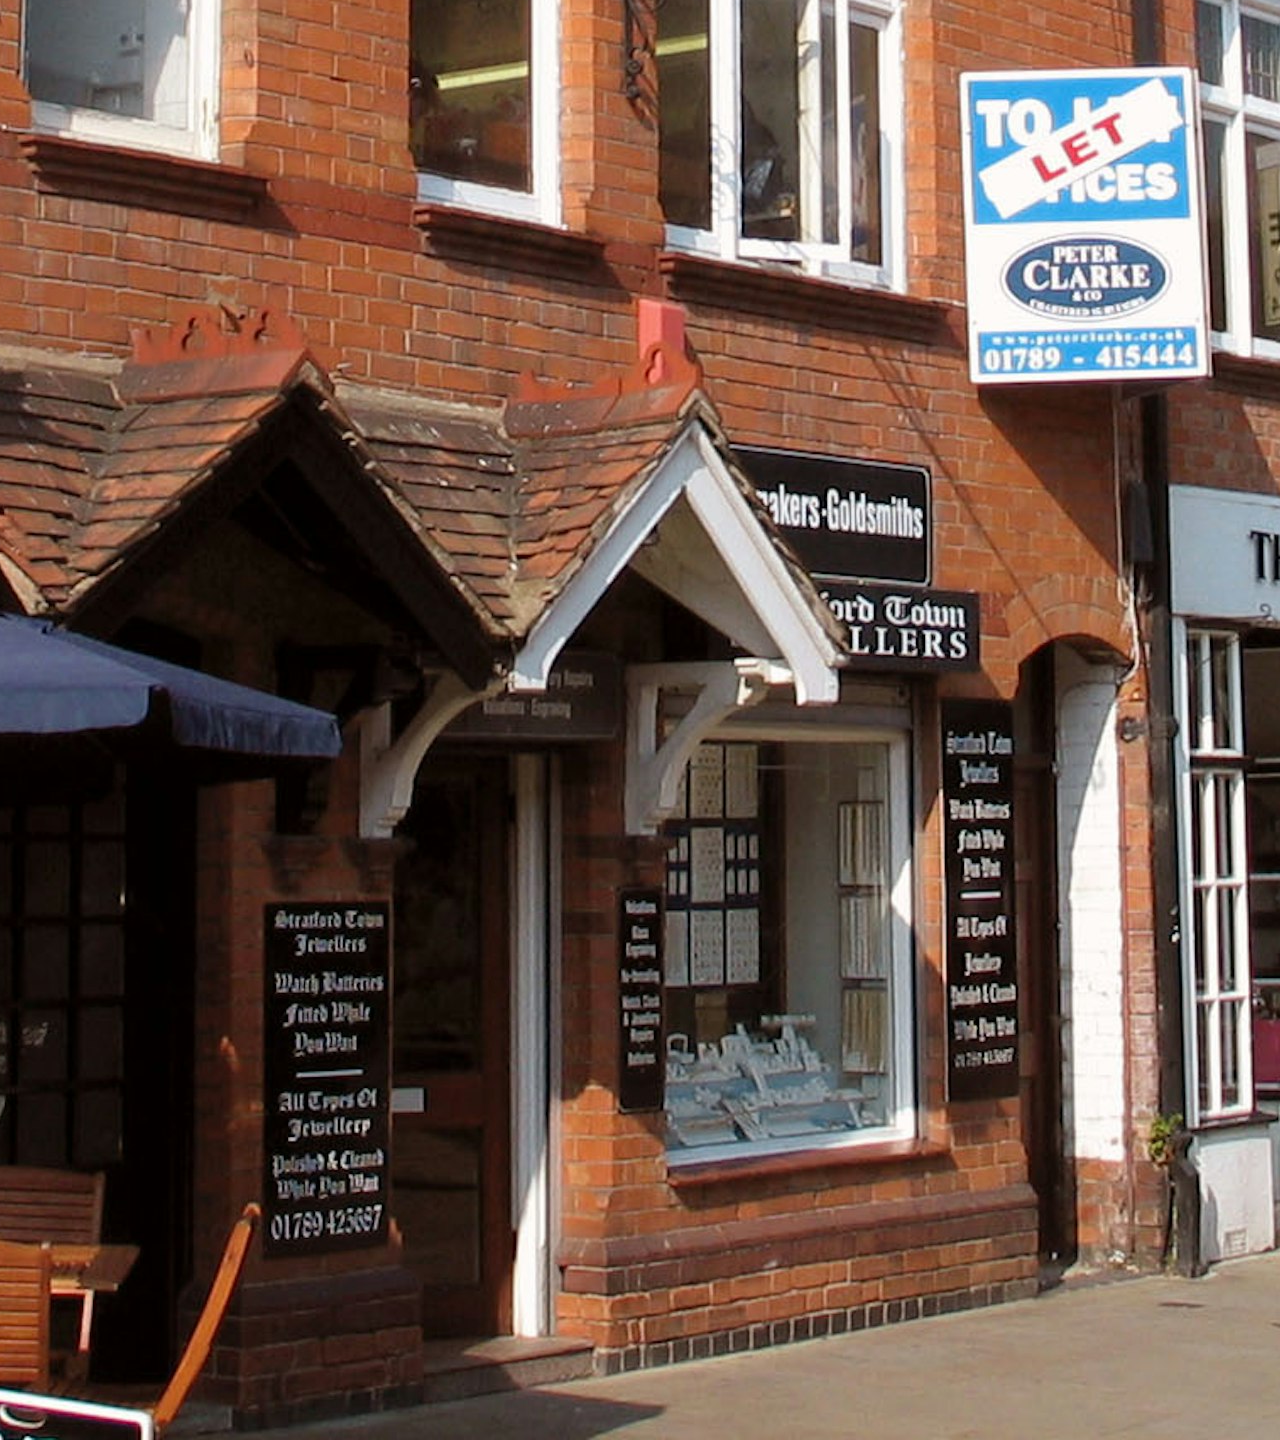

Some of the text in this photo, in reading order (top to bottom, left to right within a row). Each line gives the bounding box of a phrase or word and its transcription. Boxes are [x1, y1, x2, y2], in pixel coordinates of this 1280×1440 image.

[975, 98, 1053, 148] TO
[1031, 111, 1123, 184] LET
[1045, 162, 1179, 204] ICES
[1052, 244, 1119, 264] PETER
[1022, 260, 1152, 291] CLARKE
[1072, 290, 1103, 303] & CO
[984, 346, 1062, 372] 01789
[1096, 343, 1194, 369] 415444
[826, 488, 924, 539] Goldsmiths
[883, 594, 967, 629] Town
[850, 625, 969, 659] LLERS
[275, 909, 342, 929] Stratford
[294, 933, 367, 956] Jewellers
[275, 971, 319, 995] Watch
[293, 1031, 323, 1058] You
[278, 1092, 304, 1112] All
[287, 1117, 371, 1142] Jewellery
[327, 1150, 338, 1170] &
[270, 1212, 324, 1240] 01789
